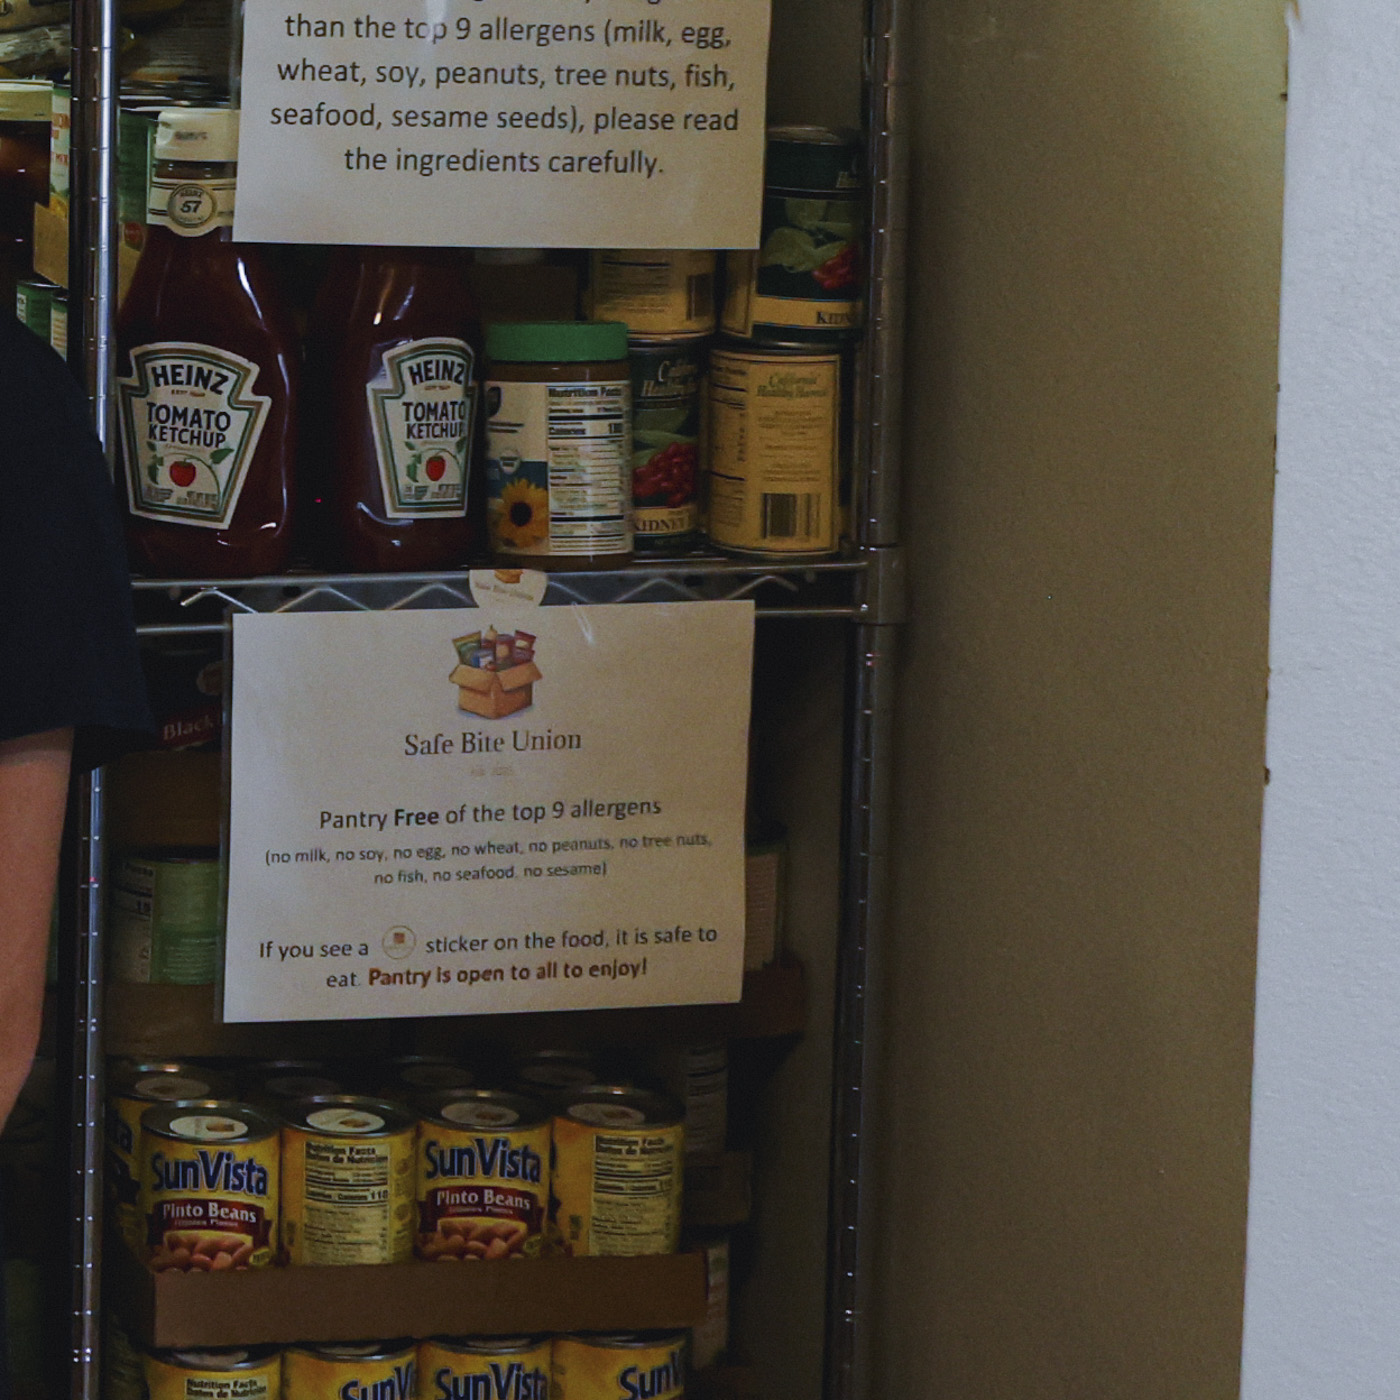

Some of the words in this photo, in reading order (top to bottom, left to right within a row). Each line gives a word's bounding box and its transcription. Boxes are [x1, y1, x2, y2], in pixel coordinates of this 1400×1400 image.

[285, 13, 344, 37] than
[354, 15, 395, 38] the
[404, 18, 447, 44] top
[456, 17, 471, 40] 9
[480, 16, 595, 47] allergens
[604, 19, 672, 47] (milk,
[681, 27, 731, 49] egg,
[277, 58, 366, 86] wheat,
[376, 66, 425, 88] soy,
[436, 64, 545, 89] peanuts,
[555, 65, 607, 86] tree
[615, 66, 676, 91] nuts,
[685, 63, 734, 91] fish,
[271, 102, 382, 130] seafood,
[392, 110, 488, 128] sesame
[497, 105, 584, 134] seeds),
[594, 106, 675, 134] please
[684, 108, 738, 130] read
[344, 147, 387, 170] the
[397, 148, 540, 176] ingredients
[548, 150, 663, 179] carefully.
[180, 200, 203, 214] 57
[151, 365, 229, 395] HEINZ
[408, 360, 466, 386] HEINZ
[147, 402, 231, 432] TOMATO
[149, 424, 227, 448] KETCHUP
[405, 733, 454, 755] Safe
[461, 732, 505, 753] Bite
[513, 729, 581, 751] Union
[320, 810, 387, 833] Pantry
[395, 809, 439, 826] Free
[446, 804, 466, 824] of
[473, 804, 505, 822] the
[512, 804, 545, 824] top
[552, 801, 564, 819] 9
[571, 797, 662, 824] allergens
[266, 850, 291, 866] (no
[336, 851, 355, 861] no
[393, 849, 412, 860] no
[451, 846, 470, 856] no
[529, 841, 548, 852] no
[619, 838, 639, 849] no
[642, 835, 673, 848] tree
[374, 874, 394, 884] no
[433, 871, 451, 882] no
[524, 867, 543, 877] no
[547, 861, 607, 877] sesame)
[260, 941, 273, 958] If
[278, 945, 315, 964] you
[320, 944, 352, 957] see
[358, 943, 368, 956] a
[426, 935, 489, 953] sticker
[494, 938, 518, 950] on
[525, 932, 555, 949] the
[617, 928, 628, 945] it
[634, 927, 648, 944] is
[654, 925, 692, 944] safe
[697, 927, 717, 942] to
[369, 968, 431, 989] Pantry
[436, 966, 451, 984] is
[457, 968, 504, 989] open
[510, 965, 530, 980] to
[536, 961, 558, 979] all
[564, 962, 583, 978] to
[589, 957, 647, 983] enjoy!
[151, 1149, 268, 1196] SunVista
[425, 1138, 542, 1184] SunVista
[163, 1203, 204, 1219] Pinto
[208, 1202, 257, 1223] Beans
[436, 1190, 479, 1206] Pinto
[483, 1188, 531, 1210] Beans
